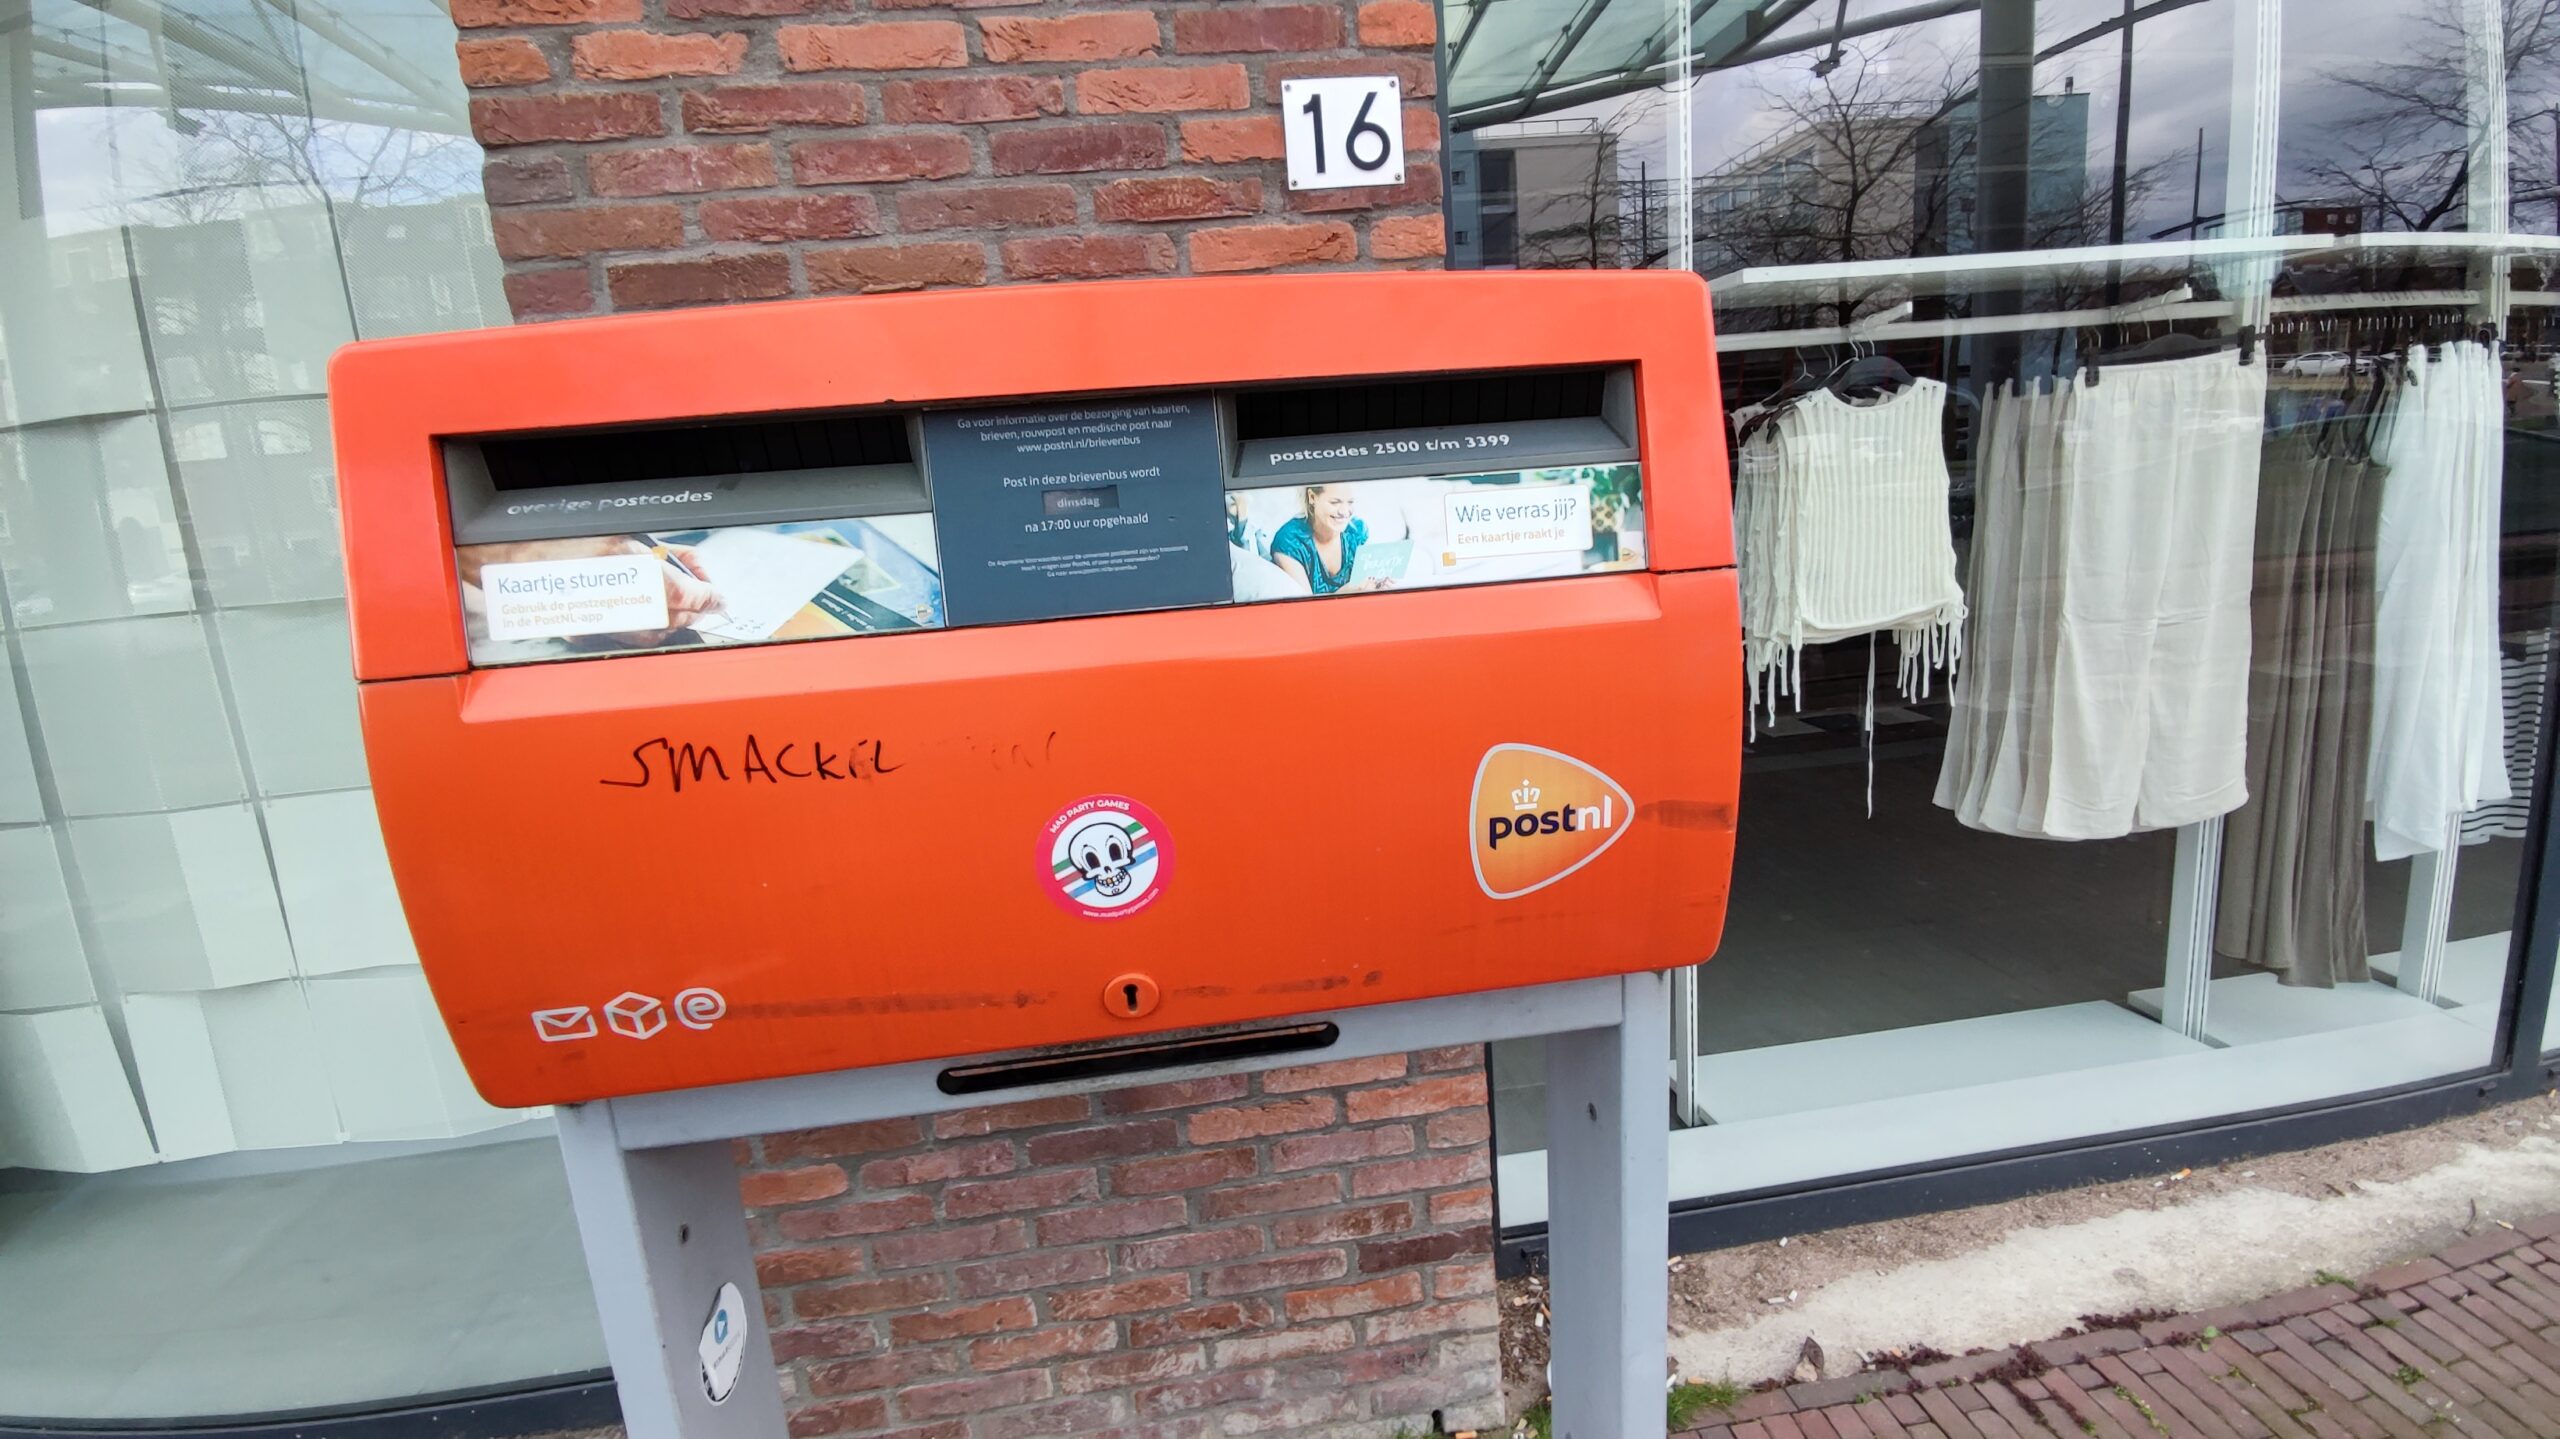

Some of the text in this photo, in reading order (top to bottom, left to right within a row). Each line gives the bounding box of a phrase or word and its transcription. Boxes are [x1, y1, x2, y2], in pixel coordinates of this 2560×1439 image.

[1303, 92, 1391, 174] 16
[958, 404, 1190, 428] Ga voor informatie over de bezorging van kaarten,
[980, 420, 1172, 442] brieven, rouwpost en medische post naar
[1016, 436, 1140, 453] www.postnl.nl/brievenbus
[1270, 434, 1510, 466] postcodes 2500 t/m 3399
[1004, 466, 1160, 488] Post in deze brievenbus wordt
[598, 490, 713, 512] postcodes
[1057, 496, 1100, 508] dinsdag
[1456, 498, 1577, 523] Wie verras jij?
[1025, 512, 1148, 533] na 17:00 uur opgehaald
[1458, 526, 1565, 545] Een kaartje raakt je
[498, 567, 638, 595] Kaartje sturen?
[502, 594, 652, 614] Gebruik de postzegelcode
[503, 612, 604, 628] in de PostNL-app
[1050, 800, 1130, 834] MAD PARTY GAMES
[1489, 794, 1612, 850] postnl
